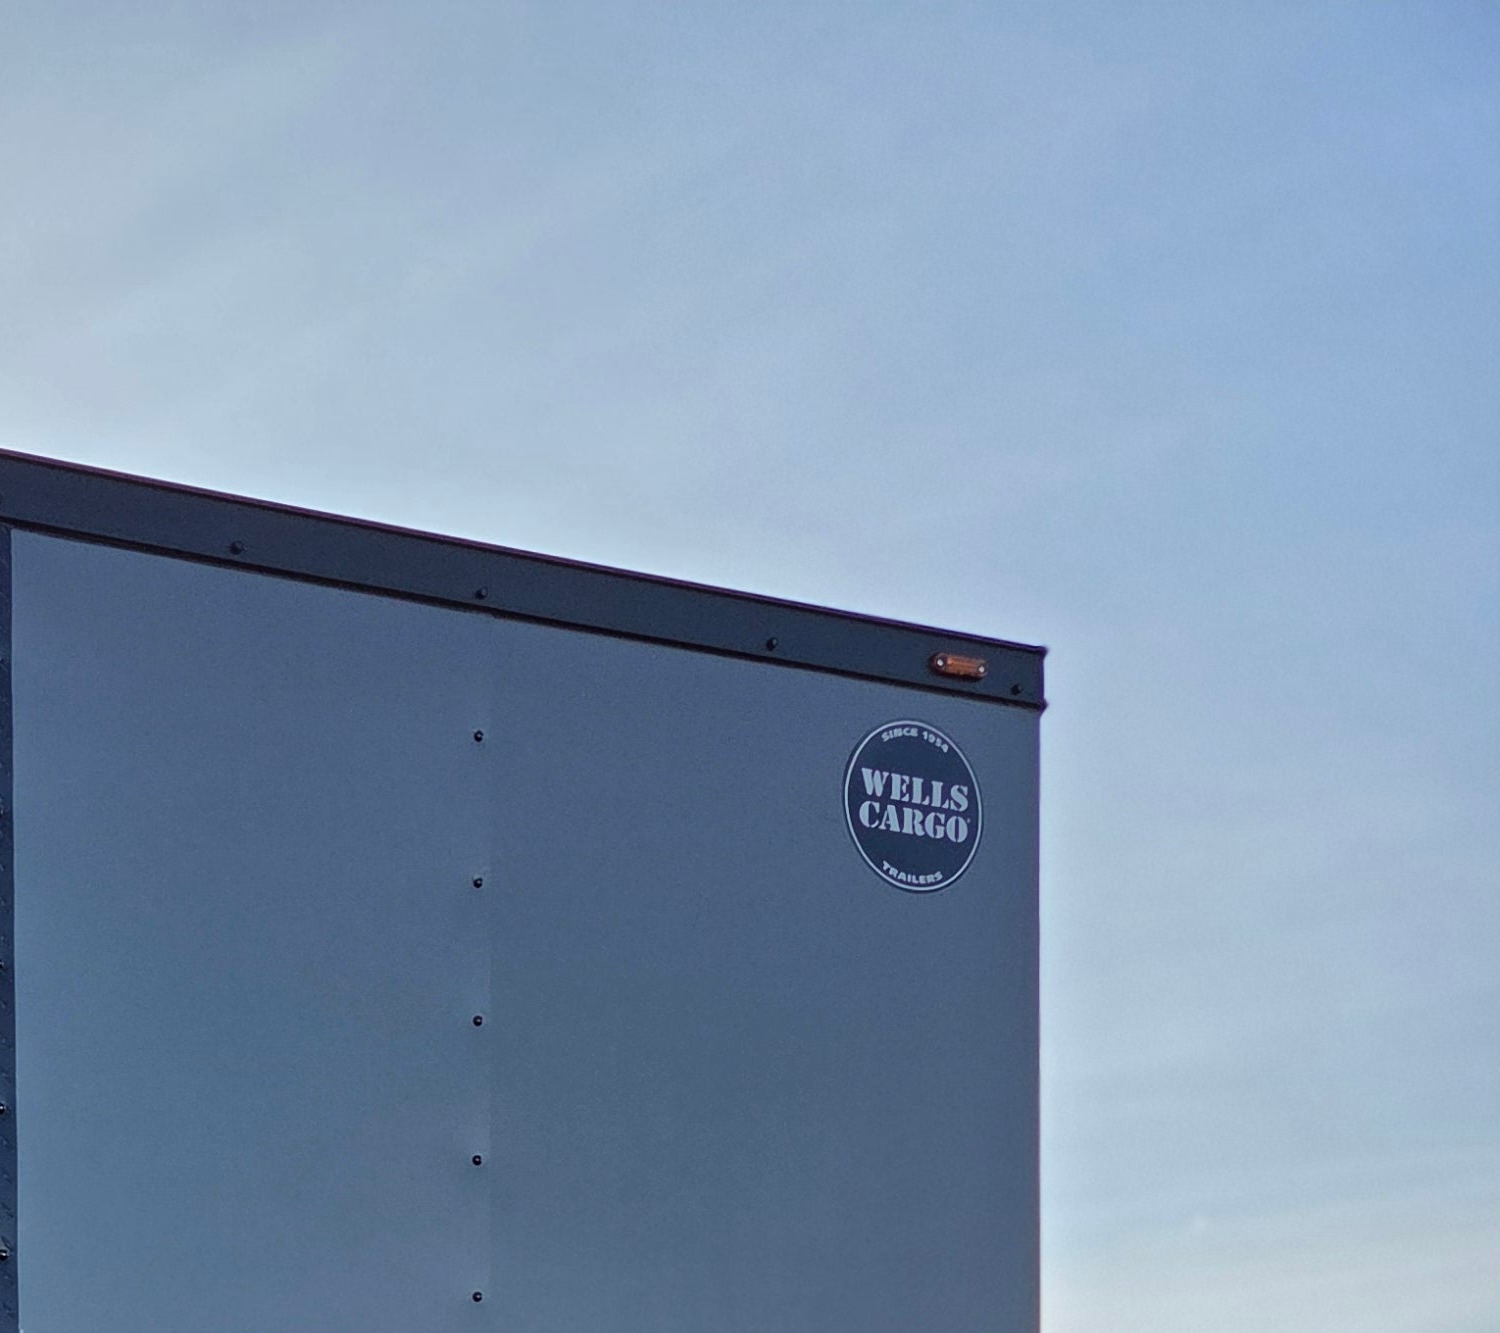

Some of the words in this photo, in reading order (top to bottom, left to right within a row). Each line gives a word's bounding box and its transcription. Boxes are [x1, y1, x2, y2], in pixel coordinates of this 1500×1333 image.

[881, 727, 918, 742] SINCE
[861, 767, 969, 812] WELLS
[859, 800, 968, 843] CARGO
[882, 860, 943, 884] TRAILERS
